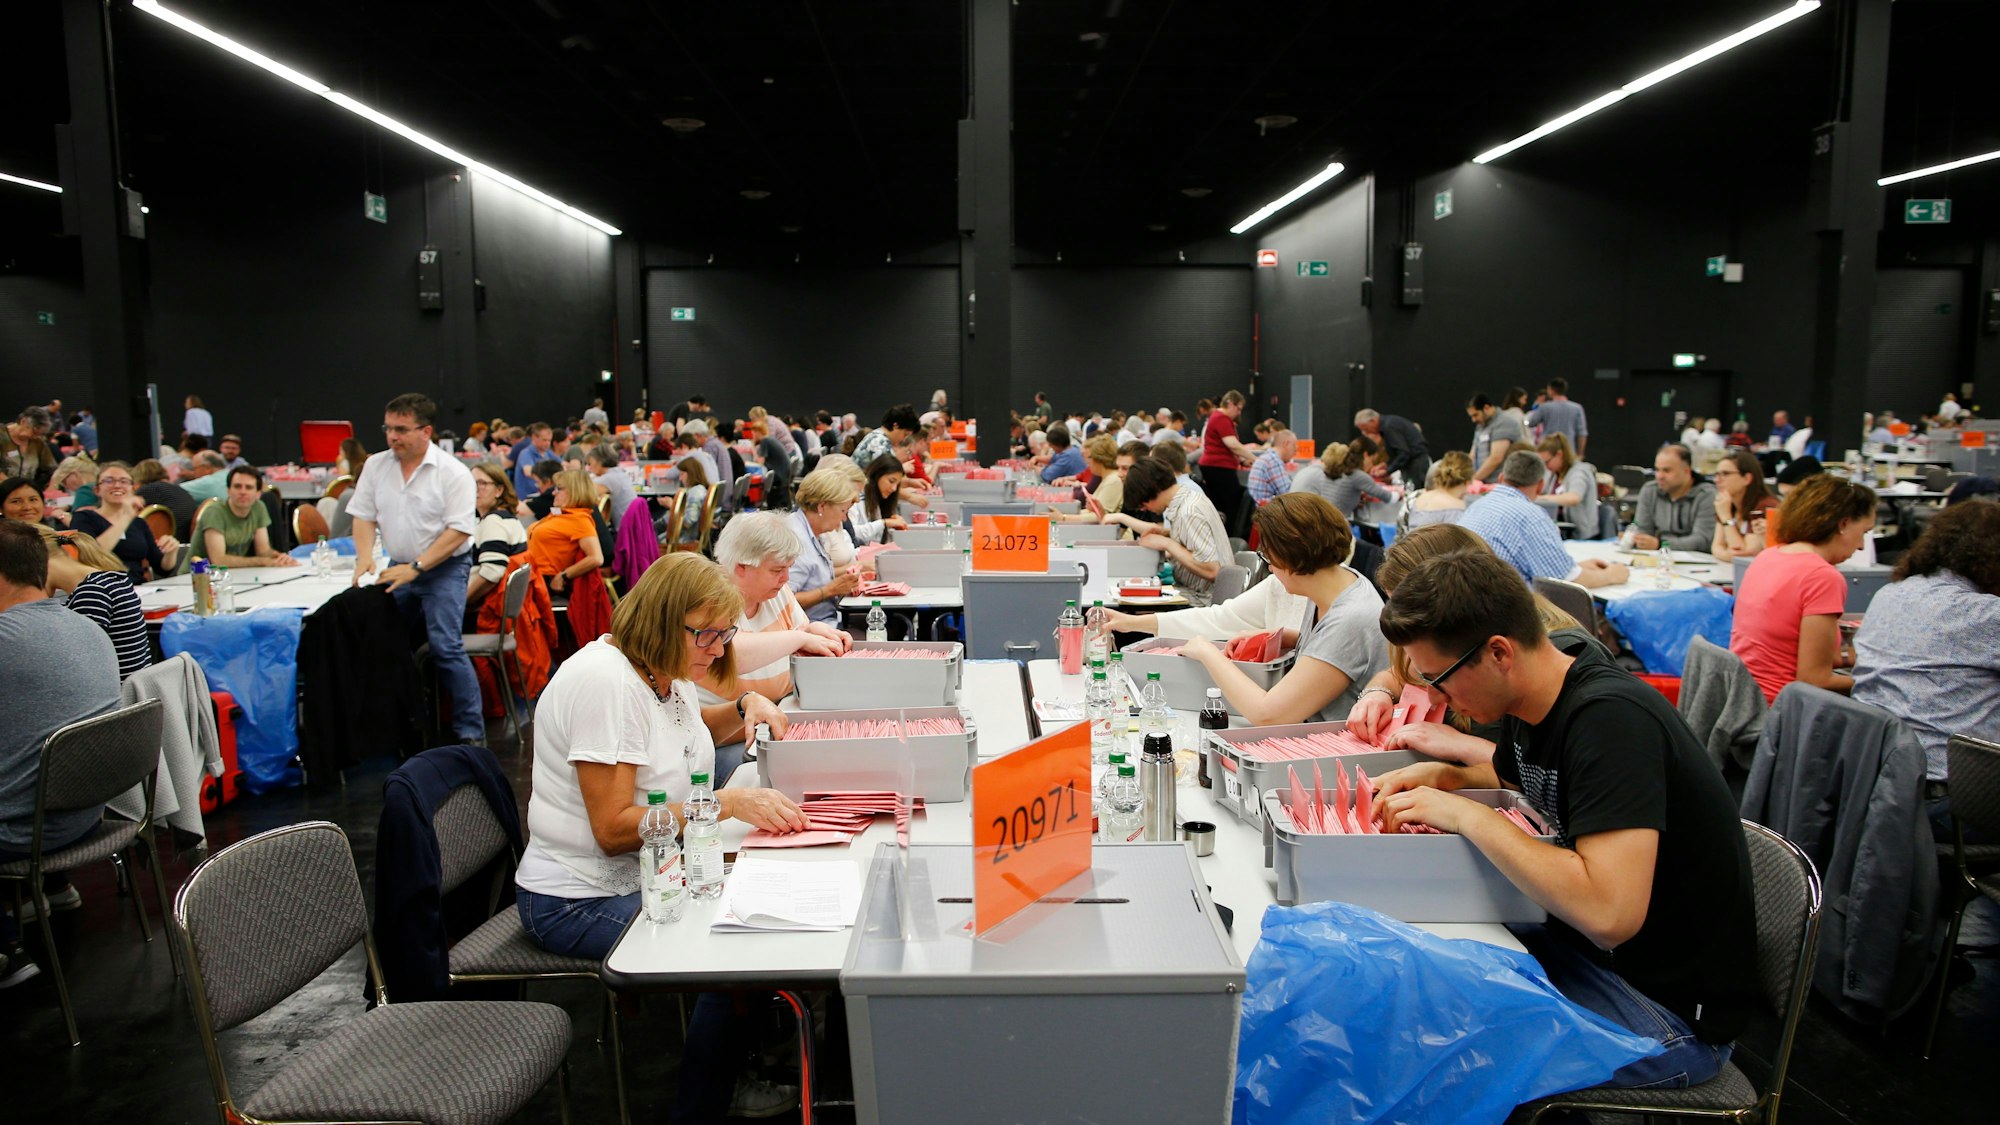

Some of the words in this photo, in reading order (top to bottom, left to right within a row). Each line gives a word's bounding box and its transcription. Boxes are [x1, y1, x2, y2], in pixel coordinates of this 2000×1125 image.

[419, 250, 438, 264] 57
[1405, 246, 1423, 260] 37
[981, 534, 1039, 551] 21073
[992, 778, 1078, 865] 20971
